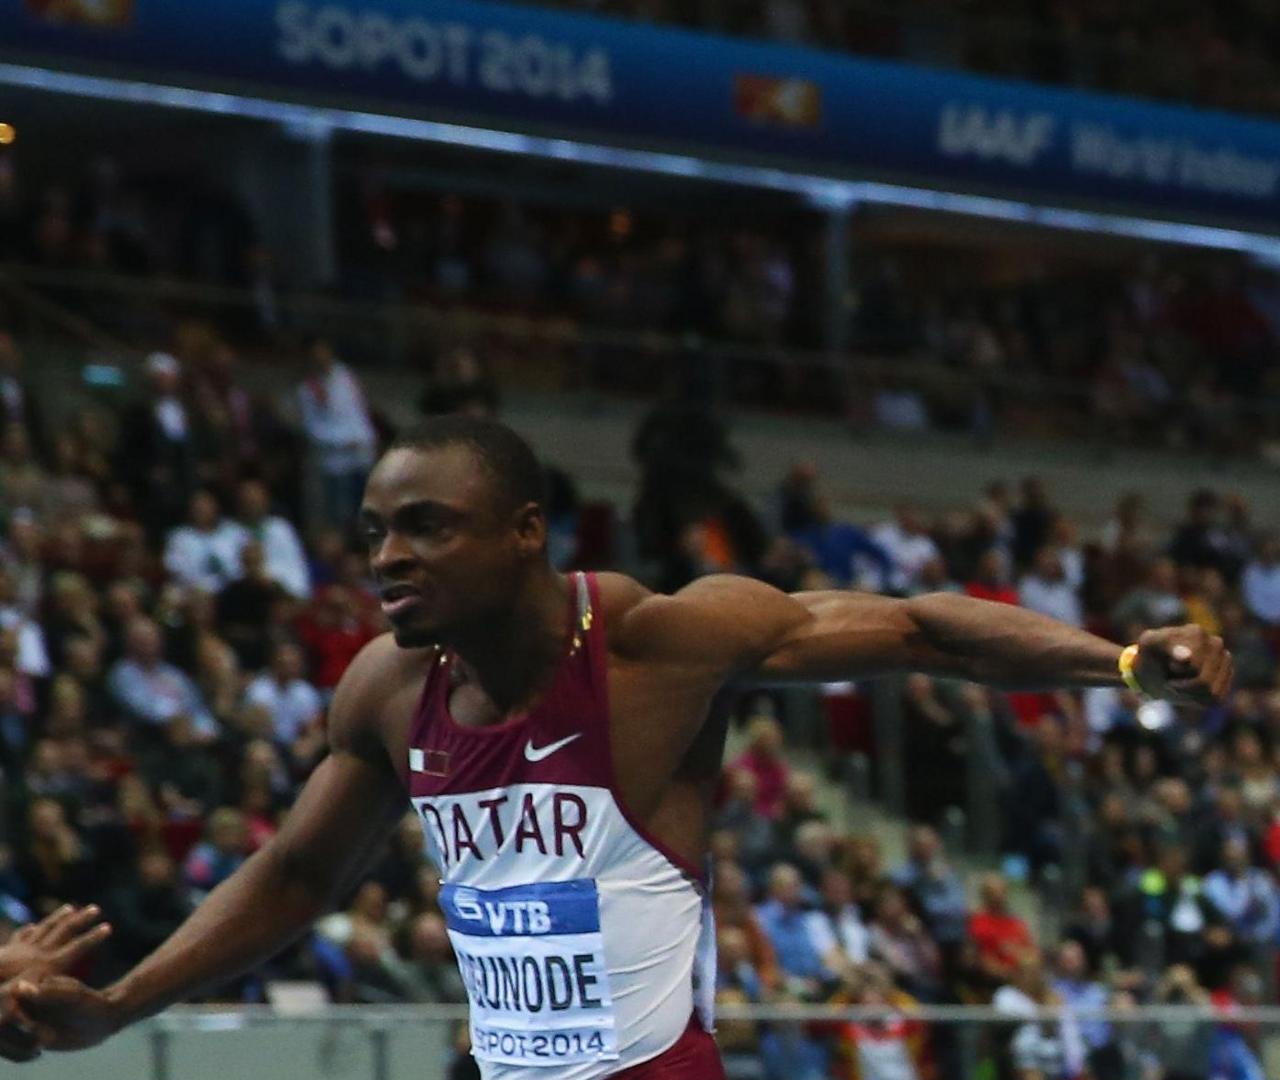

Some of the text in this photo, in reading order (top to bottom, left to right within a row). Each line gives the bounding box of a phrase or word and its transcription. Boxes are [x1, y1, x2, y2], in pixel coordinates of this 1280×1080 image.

[275, 8, 612, 104] SOPOT 2014
[484, 900, 551, 934] VTB
[530, 1031, 605, 1058] 2014
